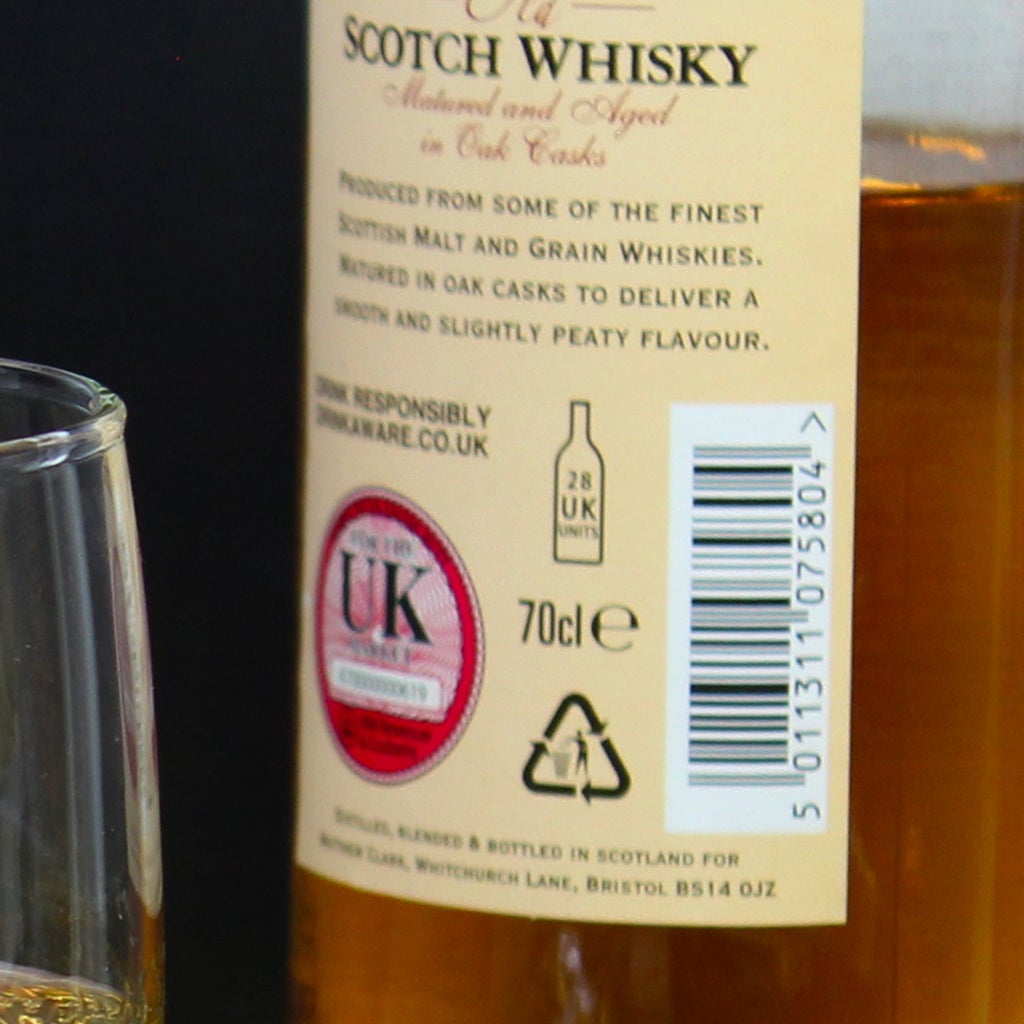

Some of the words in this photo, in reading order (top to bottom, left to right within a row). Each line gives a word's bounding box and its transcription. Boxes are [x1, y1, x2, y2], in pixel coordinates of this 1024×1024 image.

[344, 15, 500, 77] SCOTCH
[518, 34, 757, 87] WHISKY
[502, 88, 563, 119] and
[570, 88, 679, 138] Aged
[426, 186, 483, 213] FROM
[492, 194, 558, 217] SOME
[568, 200, 600, 220] OF
[609, 202, 660, 222] THE
[670, 203, 764, 225] FINEST
[413, 223, 466, 251] MALT
[473, 236, 520, 258] AND
[529, 237, 608, 263] GRAIN
[618, 241, 764, 266] WHISKIES.
[416, 270, 436, 292] IN
[443, 273, 484, 297] OAK
[492, 278, 566, 303] CASKS
[576, 285, 608, 305] TO
[619, 287, 732, 309] DELIVER
[743, 289, 760, 308] A
[395, 307, 432, 333] AND
[439, 314, 542, 343] SLIGHTLY
[551, 325, 629, 348] PEATY
[640, 329, 770, 351] FLAVOUR.
[567, 470, 592, 491] 28
[561, 497, 598, 522] UK
[341, 550, 433, 646] UK
[517, 598, 582, 648] 70cl
[570, 847, 589, 862] IN
[598, 849, 695, 868] SCOTLAND
[703, 853, 740, 868] FOR
[587, 877, 669, 897] BRISTOL
[676, 882, 732, 898] BS14
